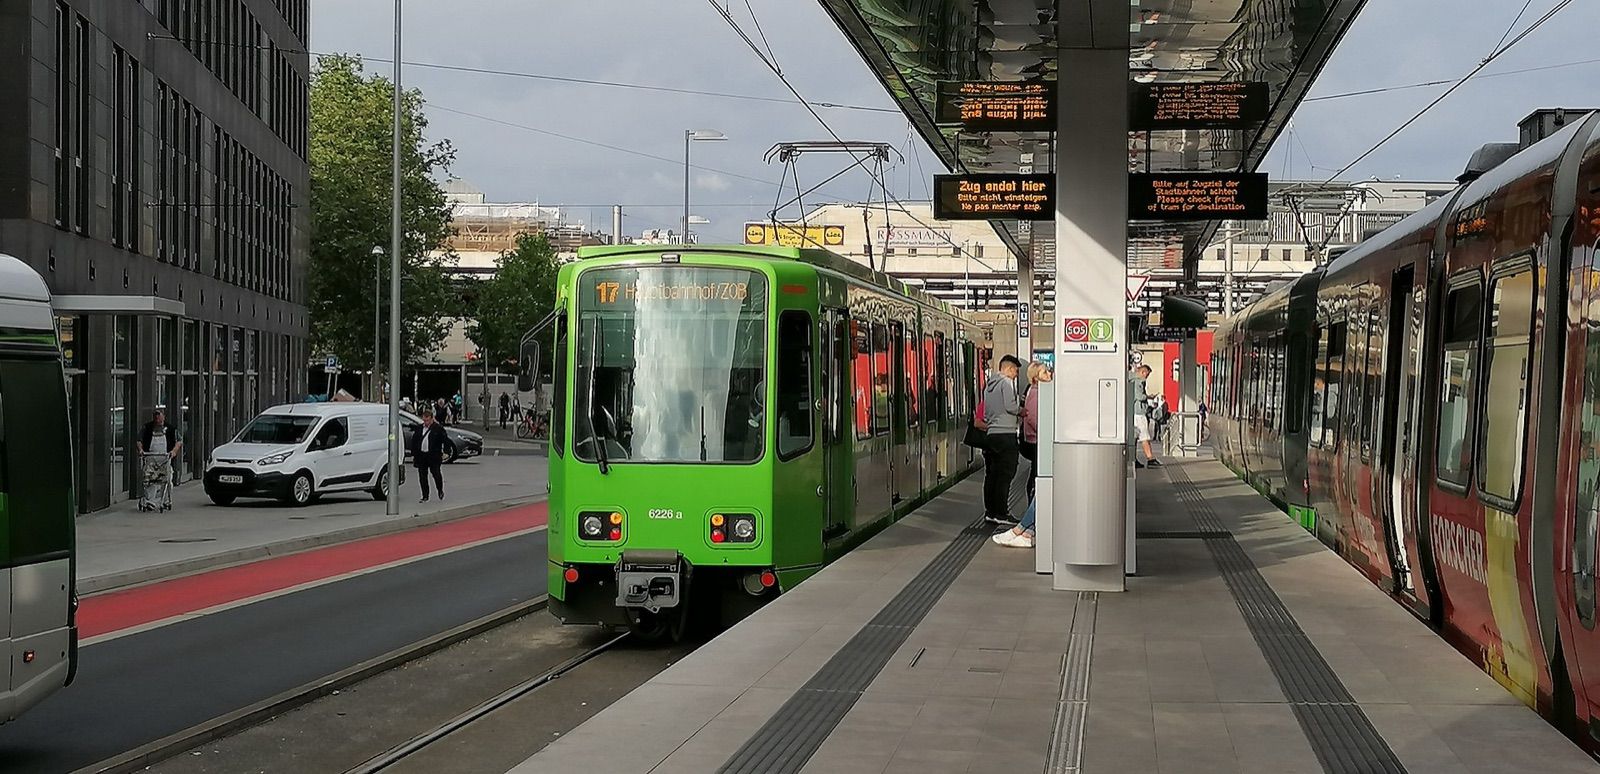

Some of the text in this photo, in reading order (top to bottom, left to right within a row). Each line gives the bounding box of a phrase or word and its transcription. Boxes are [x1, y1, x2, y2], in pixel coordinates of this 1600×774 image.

[959, 181, 1046, 193] Zug endet hier
[1152, 180, 1240, 189] Bitte auf Zugziel der
[1004, 194, 1048, 203] einsteigen
[1214, 196, 1235, 204] front
[974, 204, 990, 212] pas
[1147, 204, 1158, 212] of
[1182, 204, 1195, 212] for
[596, 281, 748, 304] 17 Hauptbahnhof/ZOB
[1067, 326, 1086, 335] SOS
[648, 509, 683, 519] 6226 a
